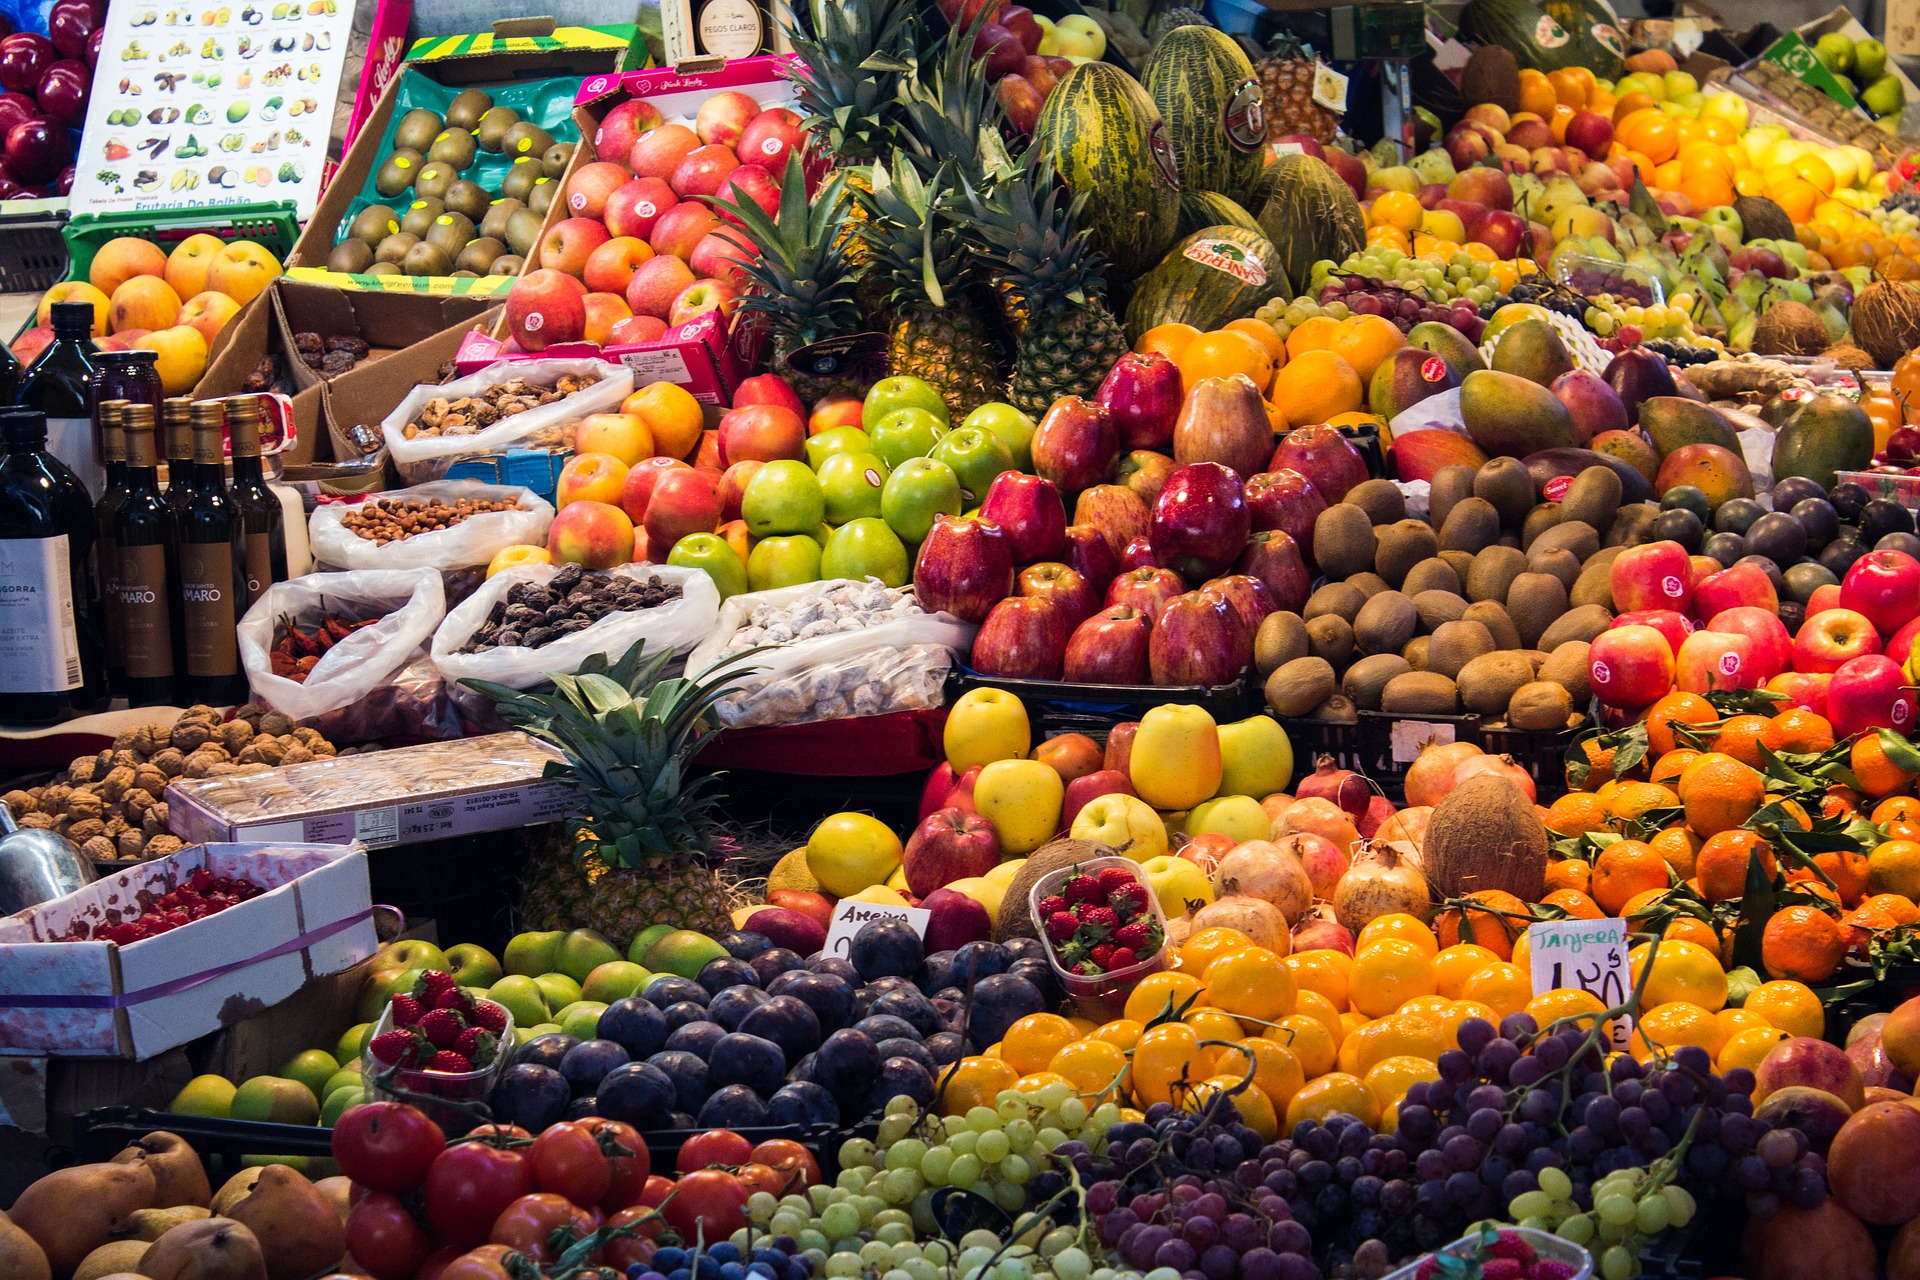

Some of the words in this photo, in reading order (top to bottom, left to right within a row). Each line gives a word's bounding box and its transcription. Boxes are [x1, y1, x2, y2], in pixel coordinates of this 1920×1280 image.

[704, 25, 728, 34] PEGOS
[729, 23, 756, 32] CLAROS
[660, 80, 681, 91] Pink
[682, 77, 708, 88] Lady
[135, 199, 183, 211] Frutaria
[188, 199, 204, 208] Do
[208, 195, 251, 206] Bolhão
[347, 278, 454, 290] www.kiwigreensun.com
[0, 585, 36, 593] GORRA
